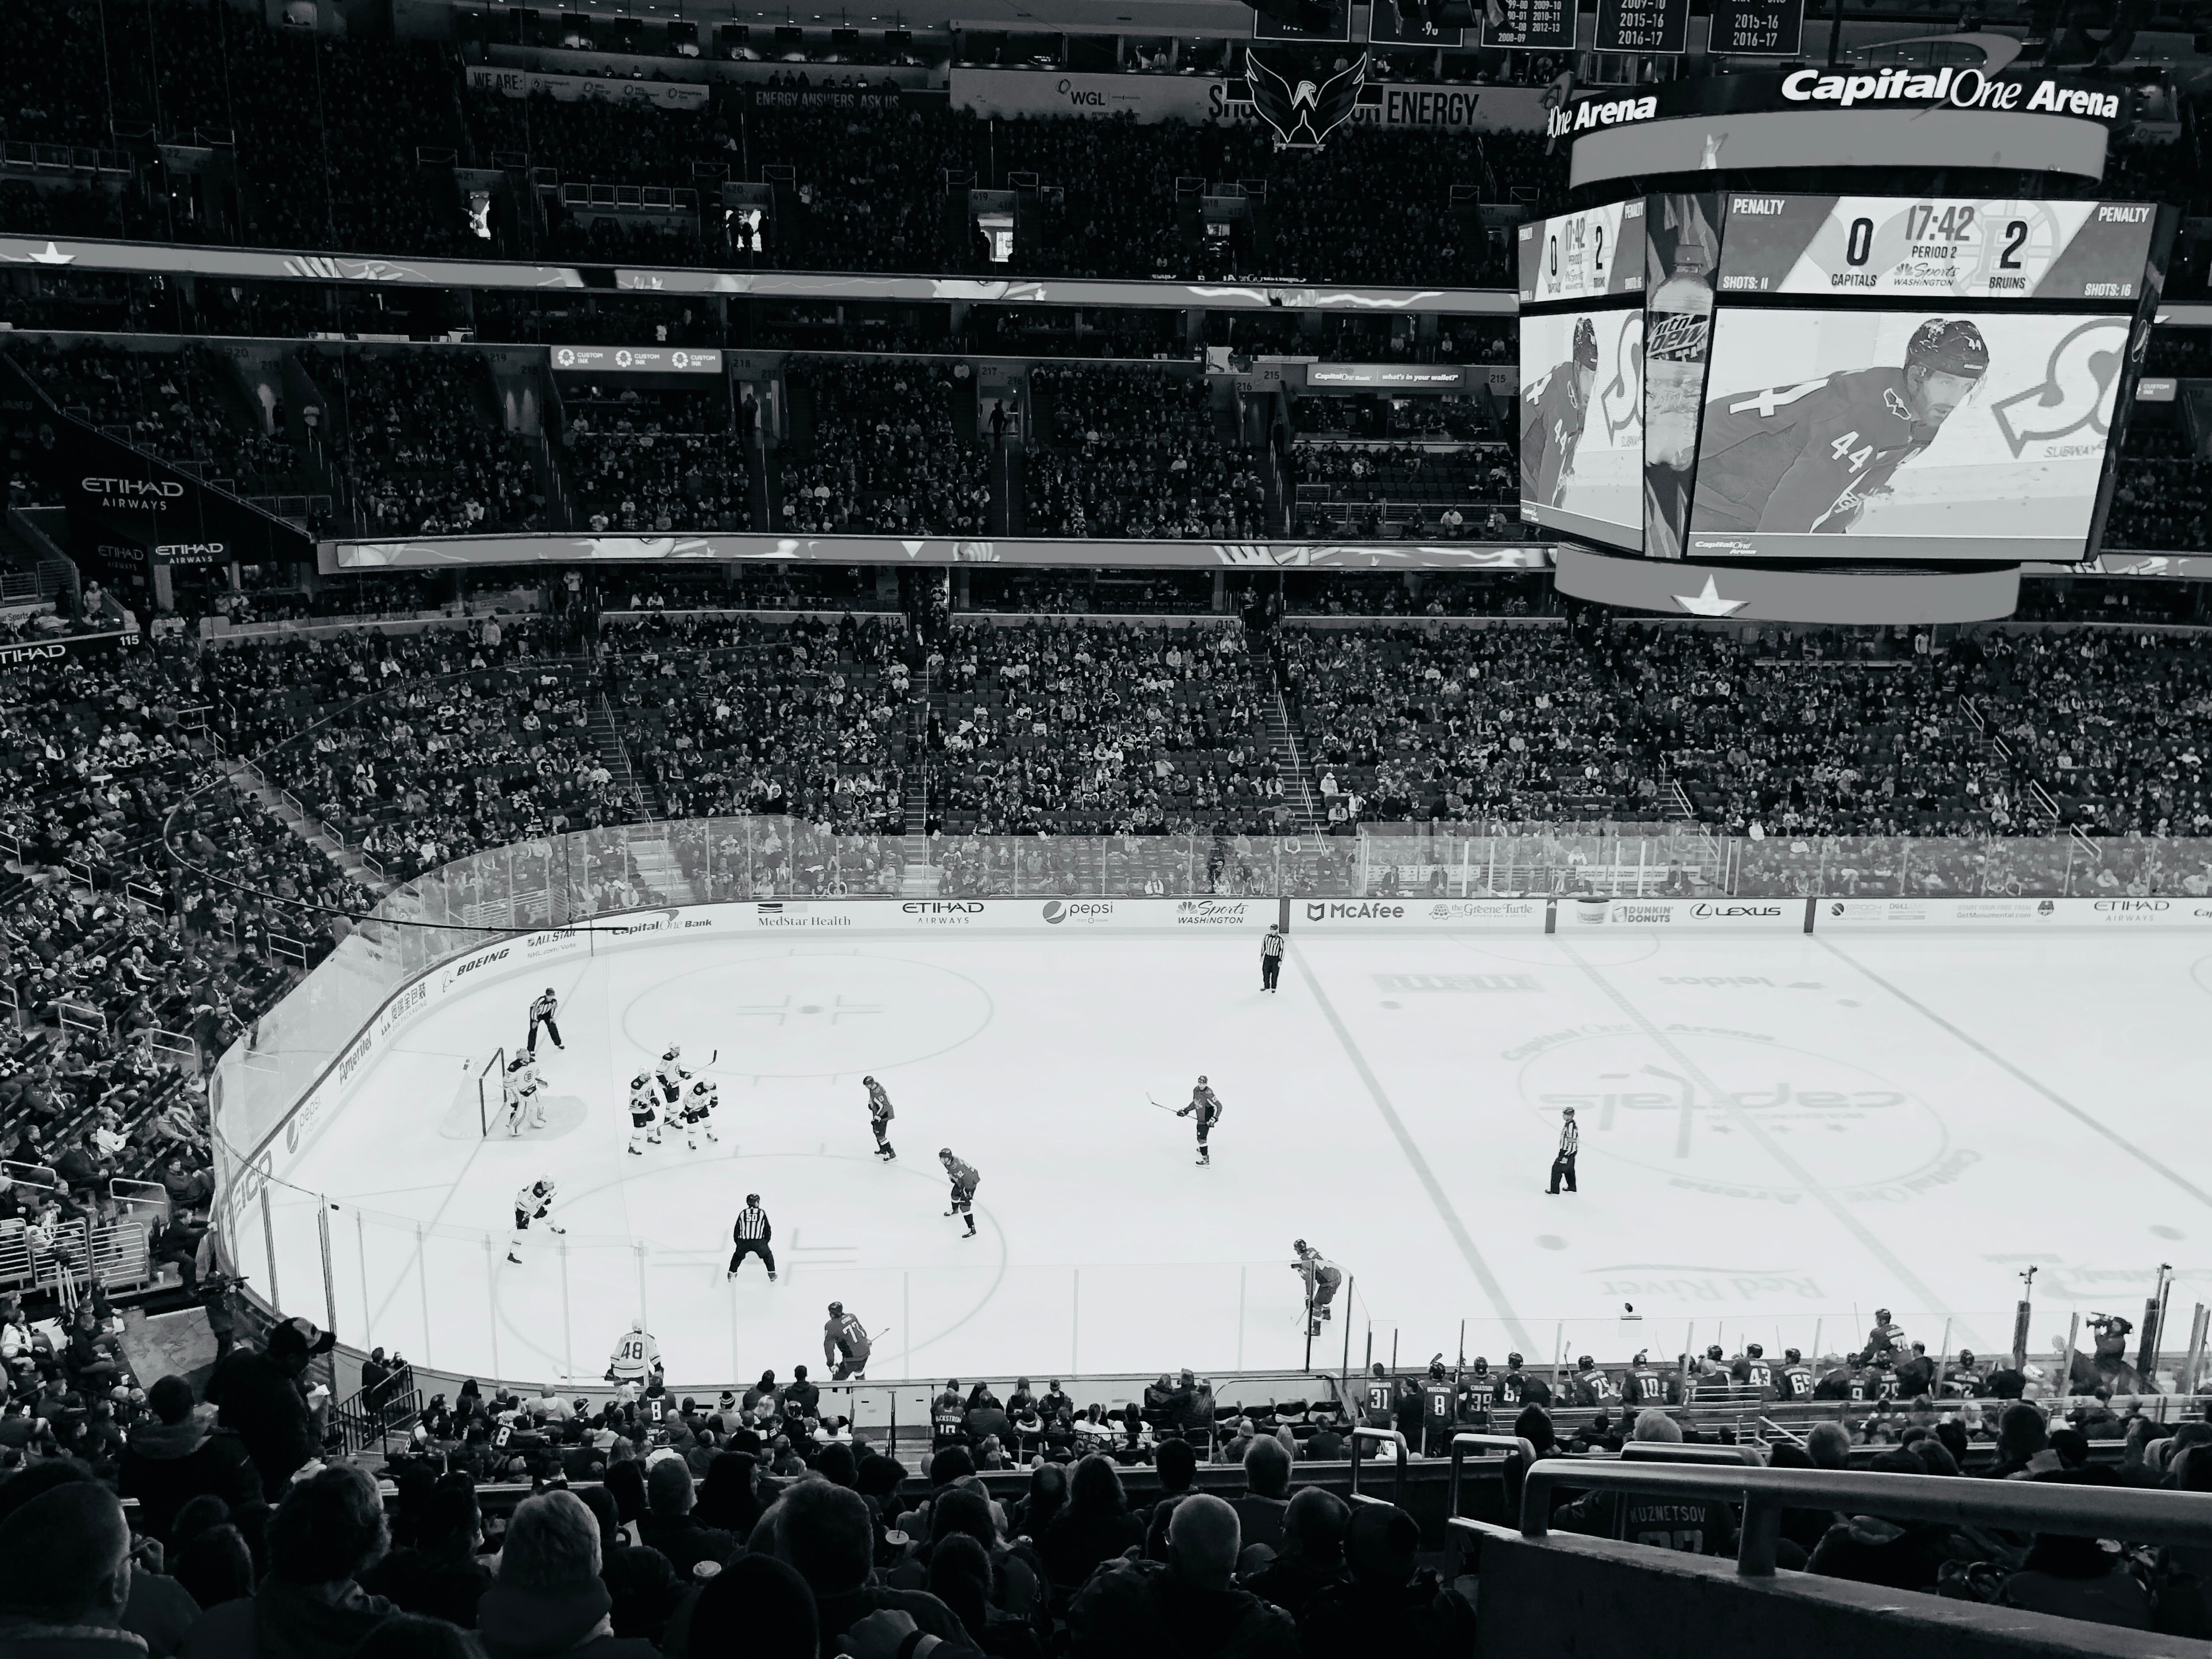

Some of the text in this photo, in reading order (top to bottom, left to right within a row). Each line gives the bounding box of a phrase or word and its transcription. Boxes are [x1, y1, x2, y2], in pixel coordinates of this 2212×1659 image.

[1532, 11, 1561, 21] 2010-11
[1619, 13, 1664, 28] 2015-16
[1734, 14, 1779, 29] 2015-16
[1532, 22, 1560, 33] 2012-13
[1497, 33, 1526, 43] 2008-09
[1617, 30, 1663, 45] 2016-17
[1733, 32, 1777, 46] 2016-17
[474, 72, 523, 91] WE ARE:
[756, 91, 798, 107] ENERGY
[861, 94, 880, 109] ASK
[884, 95, 899, 110] US
[1071, 91, 1106, 106] WGL
[2026, 80, 2119, 118] Arena
[1387, 91, 1480, 125] ENERGY
[1573, 96, 1658, 131] Arena
[1733, 198, 1785, 215] PENALTY
[2098, 206, 2149, 223] PENALTY
[1906, 206, 1975, 241] 17:42
[1566, 216, 1585, 251] 17:42
[1596, 226, 1602, 270] 2
[1846, 218, 1874, 266] 0
[2000, 220, 2028, 269] 2
[1551, 235, 1557, 276] 0
[1912, 246, 1957, 258] PERIOD 2
[1914, 262, 1960, 278] Sports
[1723, 276, 1759, 289] SHOTS:
[1831, 274, 1877, 287] CAPITALS
[1893, 278, 1954, 286] WASHINGTON
[1989, 277, 2026, 289] BRUINS
[2085, 284, 2132, 297] SHOTS: 16
[577, 352, 603, 360] CUSTOM
[734, 359, 751, 368] 218
[981, 367, 997, 376] 217
[1264, 371, 1280, 379] 215
[1490, 374, 1506, 383] 215
[1007, 377, 1023, 385] 216
[1236, 382, 1252, 391] 216
[1831, 431, 1873, 474] 44
[82, 478, 184, 497] ETIHAD
[102, 498, 167, 511] AIRWAYS
[98, 544, 144, 561] ETIHAD
[155, 542, 224, 555] ETIHAD
[107, 561, 138, 572] AIRWAYS
[169, 556, 213, 564] AIRWAYS
[119, 635, 139, 646] 115
[0, 645, 66, 664] TIHAD
[902, 902, 984, 913] ETIHAD
[1070, 901, 1113, 917] pepsi
[1198, 901, 1249, 916] Sports
[1331, 902, 1405, 918] McAfee
[1464, 904, 1502, 916] Greene
[1501, 904, 1534, 914] Turtle
[1629, 906, 1674, 914] DUNKIN'
[1716, 907, 1781, 916] LEXUS
[2094, 901, 2170, 911] ETIHAD
[685, 918, 712, 928] Bank
[758, 916, 852, 926] MedStar Health
[1627, 914, 1671, 923] DONUTS
[457, 948, 510, 976] BOEING
[300, 1090, 321, 1133] pepsi
[746, 1213, 758, 1222] 50
[842, 1321, 866, 1343] 77
[621, 1342, 643, 1360] 48
[1749, 1367, 1771, 1386] 43
[1640, 1378, 1659, 1398] 10
[1371, 1389, 1388, 1410] 31
[1434, 1395, 1445, 1416] 8
[1470, 1393, 1493, 1412] 39
[651, 1401, 662, 1421] 8
[496, 1426, 511, 1446] 8
[1630, 1505, 1706, 1524] KUZNETSOV
